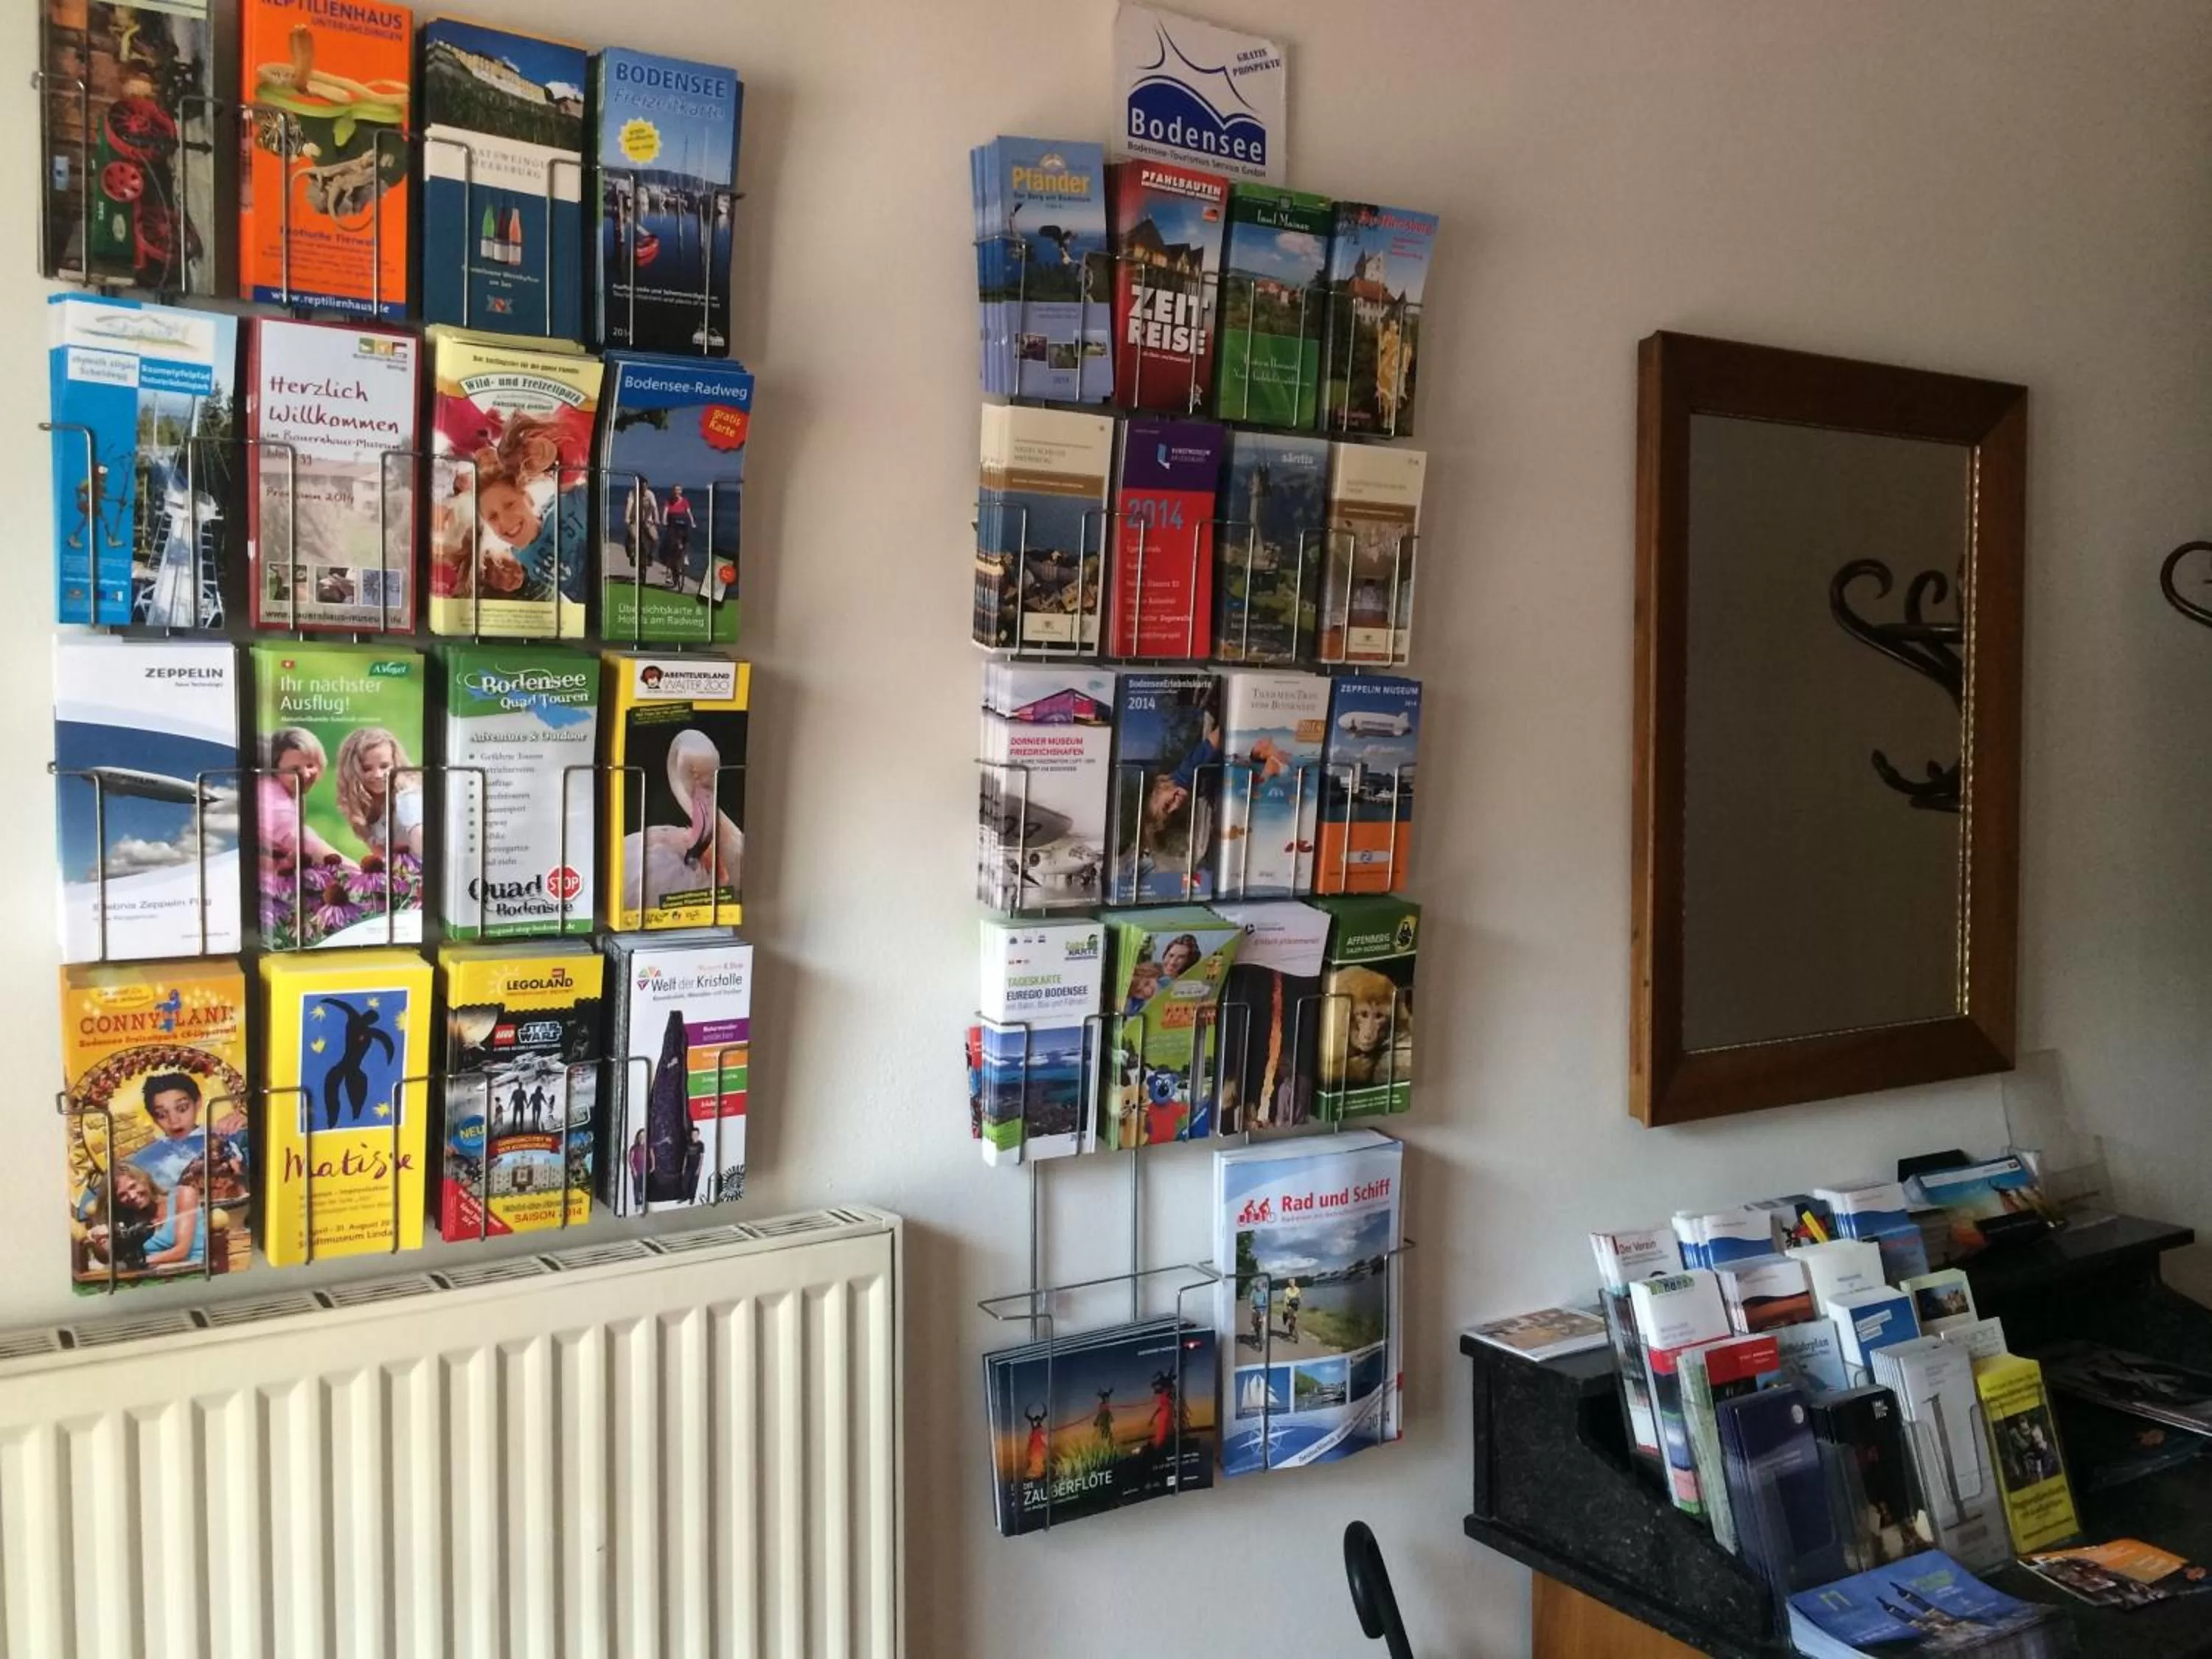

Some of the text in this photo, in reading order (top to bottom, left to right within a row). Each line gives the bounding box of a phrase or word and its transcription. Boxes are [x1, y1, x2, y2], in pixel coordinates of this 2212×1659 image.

[1237, 48, 1267, 62] GRATIS
[1232, 59, 1281, 77] PROSPEKTE
[616, 62, 726, 98] BODENSEE
[1132, 107, 1262, 162] Bodensee
[1141, 170, 1222, 196] PFAHLBAUTEN
[280, 226, 382, 247] Eotische Tierwel
[1128, 284, 1209, 327] ZEIT
[1127, 316, 1206, 355] REISE
[270, 375, 369, 403] Herzlich
[498, 376, 519, 386] und
[625, 375, 748, 400] Bodensee-Radweg
[270, 403, 400, 435] Willkommen
[1127, 498, 1184, 531] 2014
[618, 601, 692, 616] Übesichtskarte
[617, 613, 647, 626] Hotls
[145, 667, 225, 679] ZEPPELIN
[281, 675, 303, 693] Ihr
[481, 673, 588, 695] Bodensee
[1341, 684, 1419, 696] ZEPPELIN MUSEUM
[280, 694, 351, 714] Ausflug!
[501, 691, 591, 710] Quad Touren
[1128, 697, 1156, 710] 2014
[1011, 737, 1084, 746] DORNIER MUSEUM
[1010, 748, 1085, 757] FRIEDRICHSHAFEN
[469, 874, 542, 905] Quad
[549, 877, 580, 891] STOP
[497, 901, 574, 918] Bodensee
[1347, 933, 1390, 946] AFFENBERG
[507, 977, 574, 990] LEGOLAND
[652, 970, 743, 992] Welt der Kristalle
[1006, 984, 1089, 1001] EUREGIO BODENSEE
[79, 1012, 160, 1036] CONNY
[521, 1023, 557, 1033] STAR
[521, 1032, 558, 1042] WARS
[1282, 1192, 1313, 1213] Rad
[1319, 1188, 1349, 1209] und
[1353, 1178, 1391, 1203] Schiff
[514, 1210, 555, 1224] SAISON
[367, 1229, 394, 1240] Linda
[1023, 1469, 1114, 1506] ZAUBERFLÖTE
